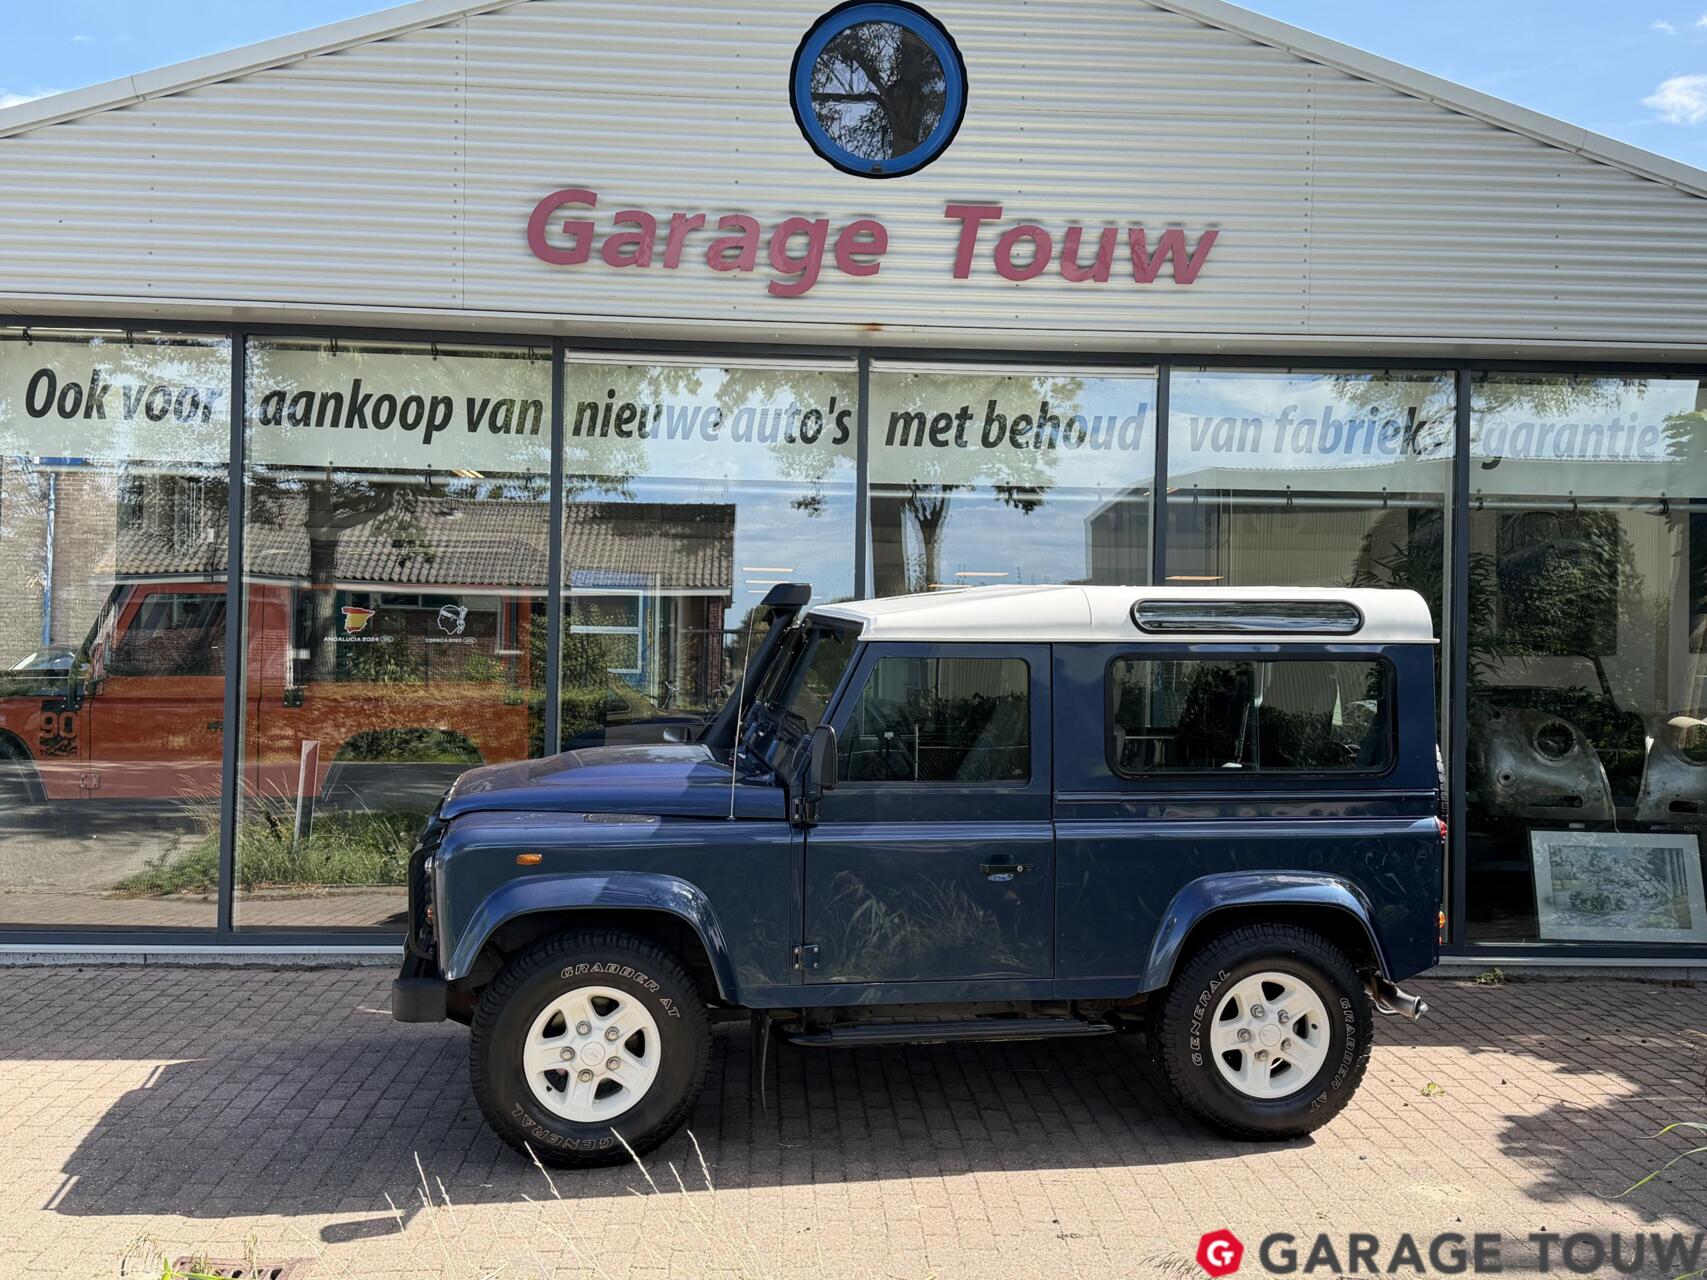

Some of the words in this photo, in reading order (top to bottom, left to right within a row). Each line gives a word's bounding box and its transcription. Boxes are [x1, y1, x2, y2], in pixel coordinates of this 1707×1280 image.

[526, 187, 889, 297] Garage
[943, 203, 1220, 285] Touw
[25, 367, 111, 420] Ook
[122, 384, 224, 423] voor
[259, 378, 453, 445] aankoop
[466, 396, 543, 436] van
[572, 389, 724, 442] nieuwe
[730, 396, 851, 446] auto's
[885, 403, 974, 449] met
[980, 399, 1148, 452] behoud
[1189, 413, 1262, 454] van
[1480, 411, 1660, 470] garantie
[40, 711, 77, 738] 90
[560, 962, 660, 993] GRABBER
[660, 998, 681, 1018] AT
[1190, 969, 1231, 1066] GENERAL
[1331, 997, 1356, 1090] GRABBER
[511, 1103, 614, 1150] GENERAL
[1310, 1091, 1328, 1113] AT
